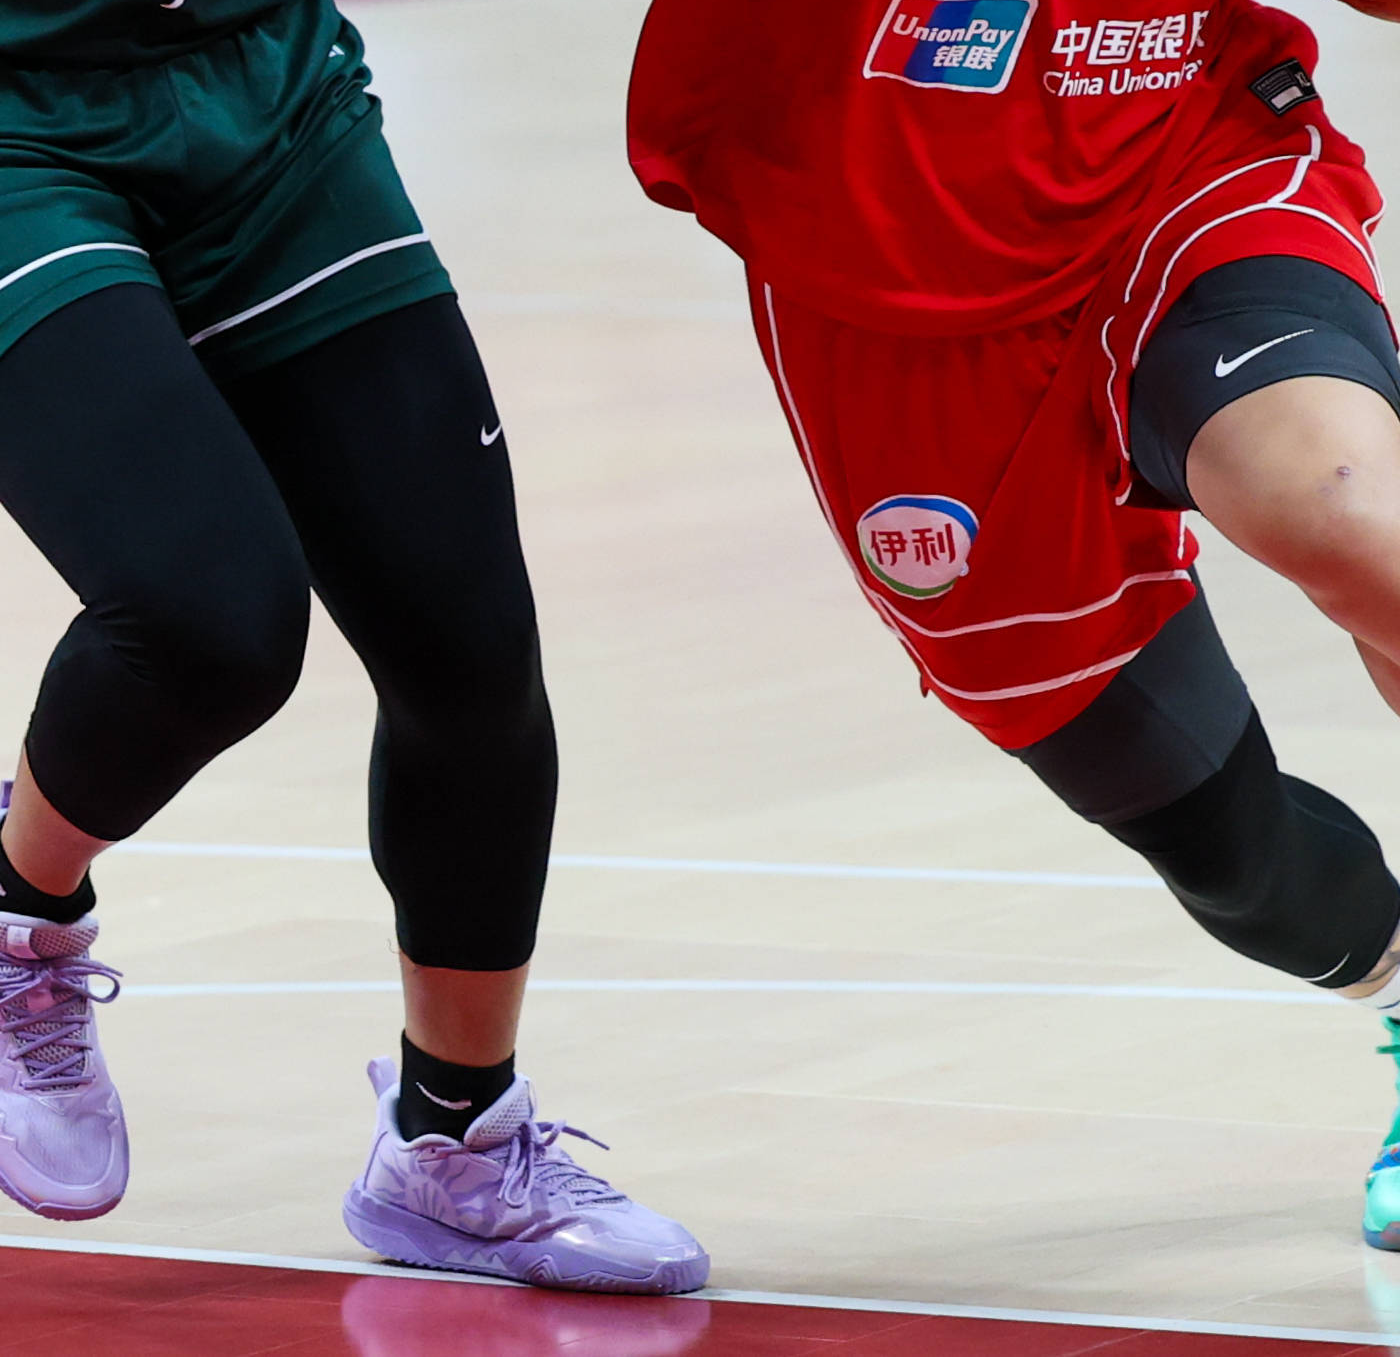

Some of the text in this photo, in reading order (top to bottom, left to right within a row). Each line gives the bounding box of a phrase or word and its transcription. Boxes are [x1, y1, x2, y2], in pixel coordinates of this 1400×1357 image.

[892, 13, 1015, 53] UnionPay
[933, 45, 999, 71] 银联
[1043, 71, 1104, 97] China
[870, 523, 957, 567] 伊利
